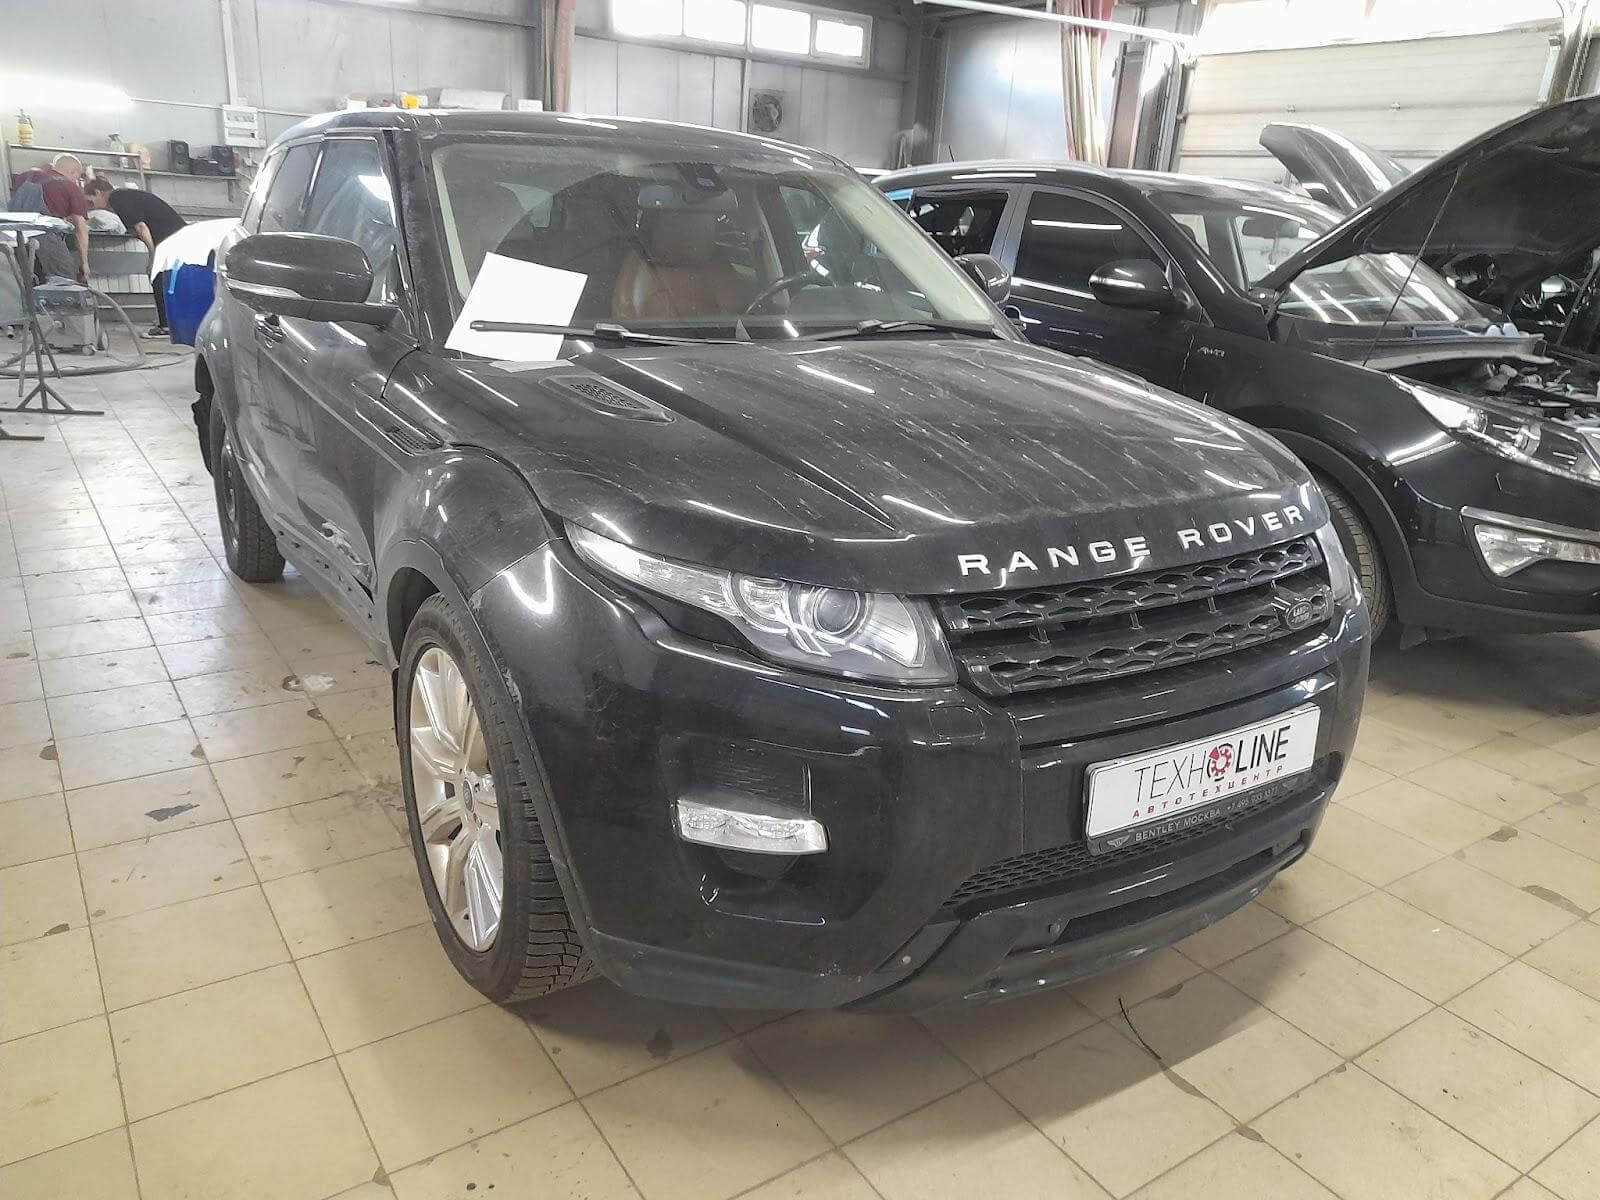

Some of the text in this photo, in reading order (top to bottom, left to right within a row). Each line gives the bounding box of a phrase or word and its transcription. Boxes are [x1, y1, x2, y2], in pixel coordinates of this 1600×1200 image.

[957, 505, 1304, 577] RANGE ROVER
[1132, 764, 1284, 819] АВТОТЕХЦЕНТР
[1135, 821, 1180, 842] BENTLEY
